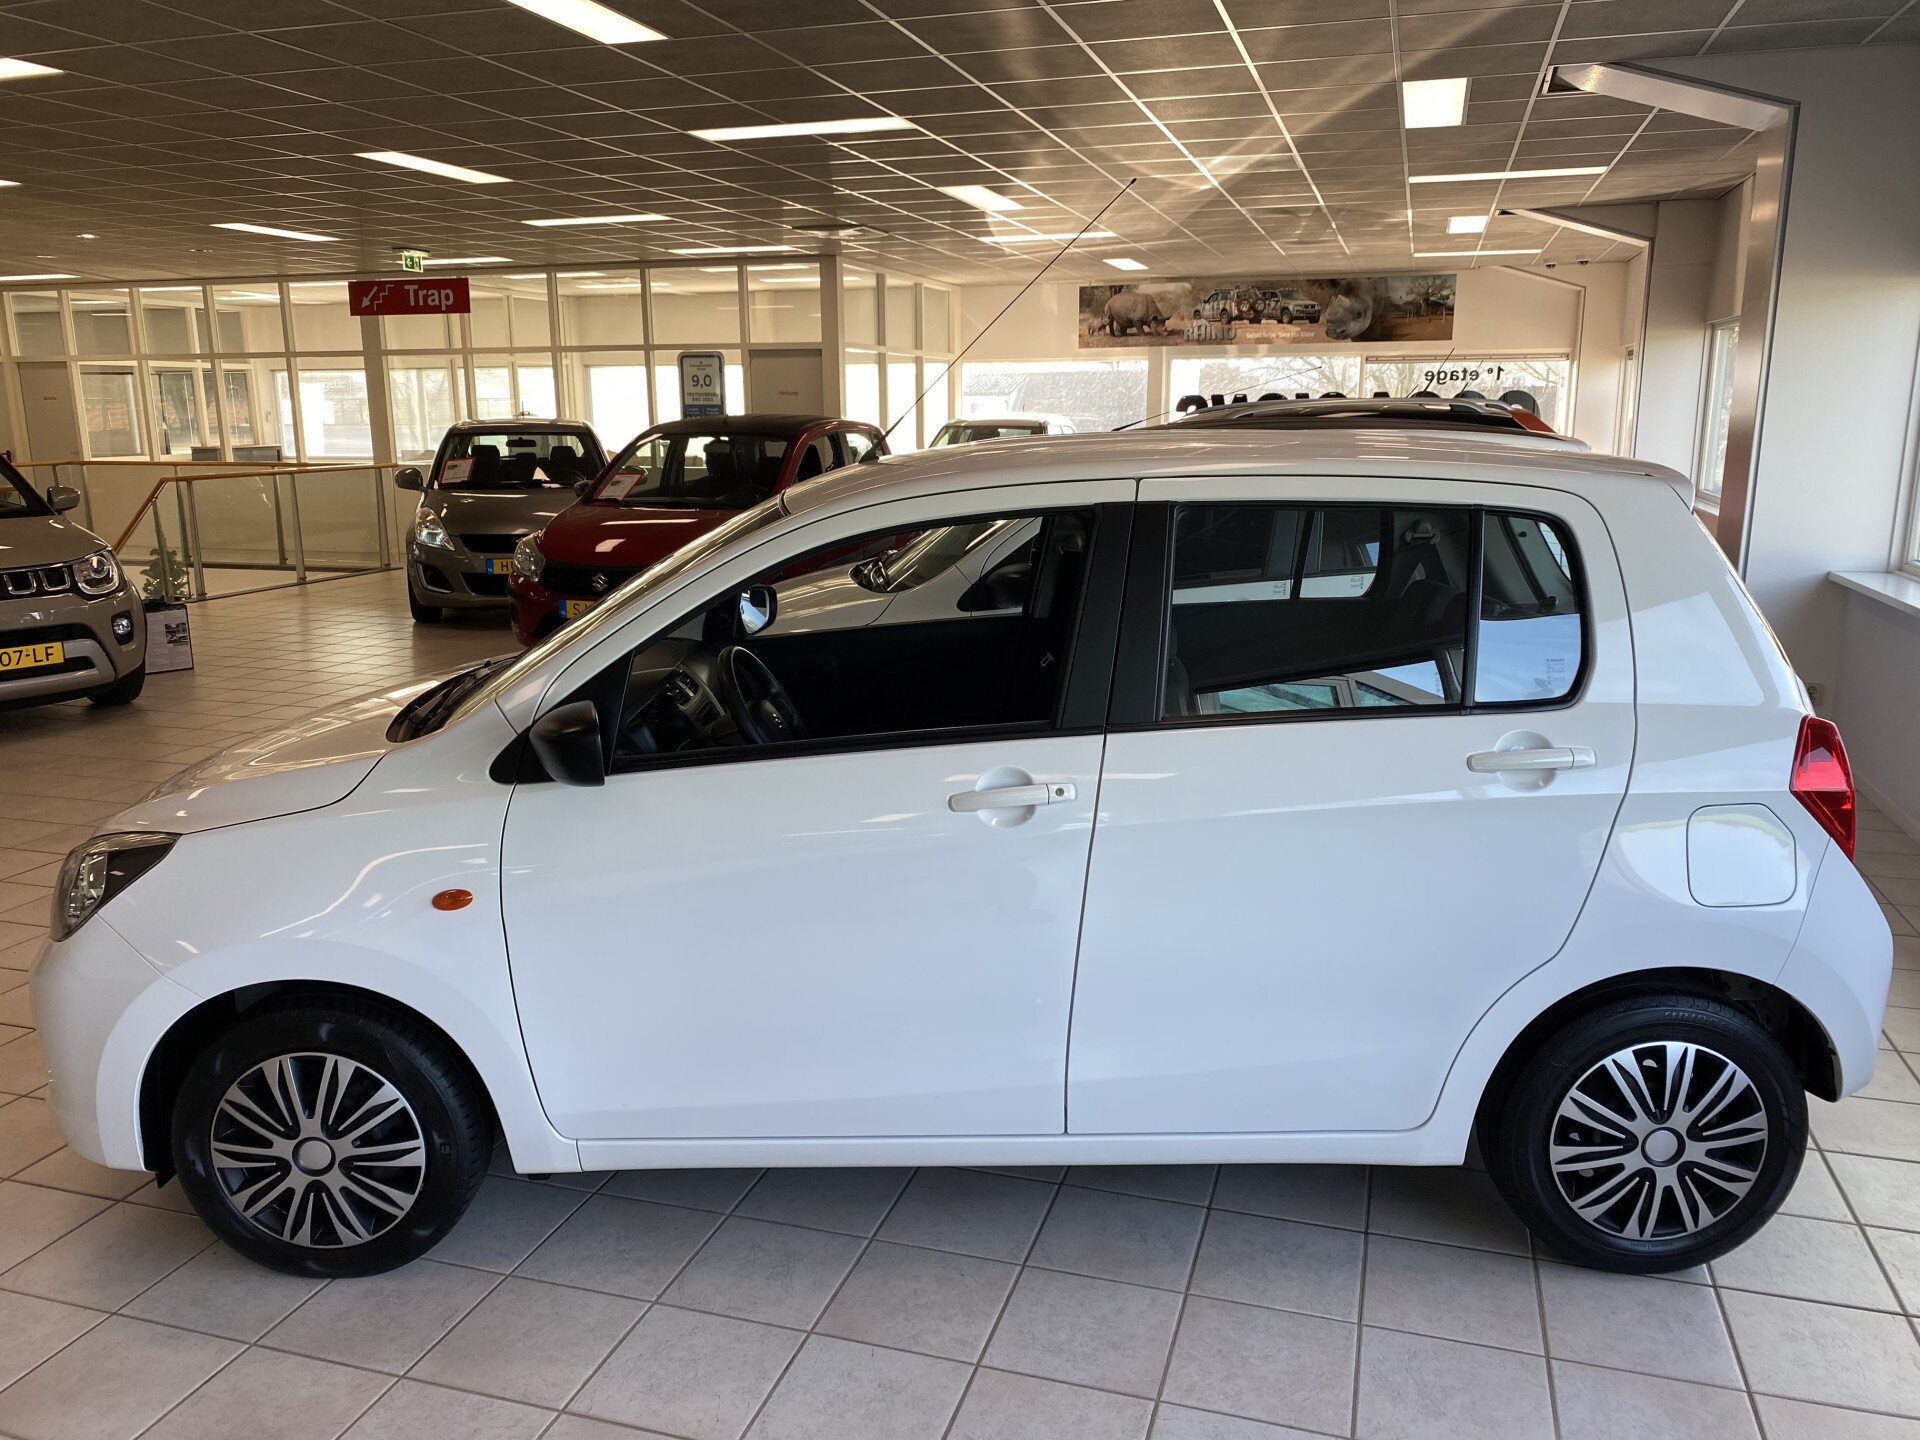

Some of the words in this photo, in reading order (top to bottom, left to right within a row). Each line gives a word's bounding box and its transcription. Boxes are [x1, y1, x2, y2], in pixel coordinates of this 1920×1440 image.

[404, 284, 454, 311] Trap
[1183, 324, 1236, 340] RHINO
[691, 374, 712, 389] 9,0
[0, 645, 55, 667] 07-LF
